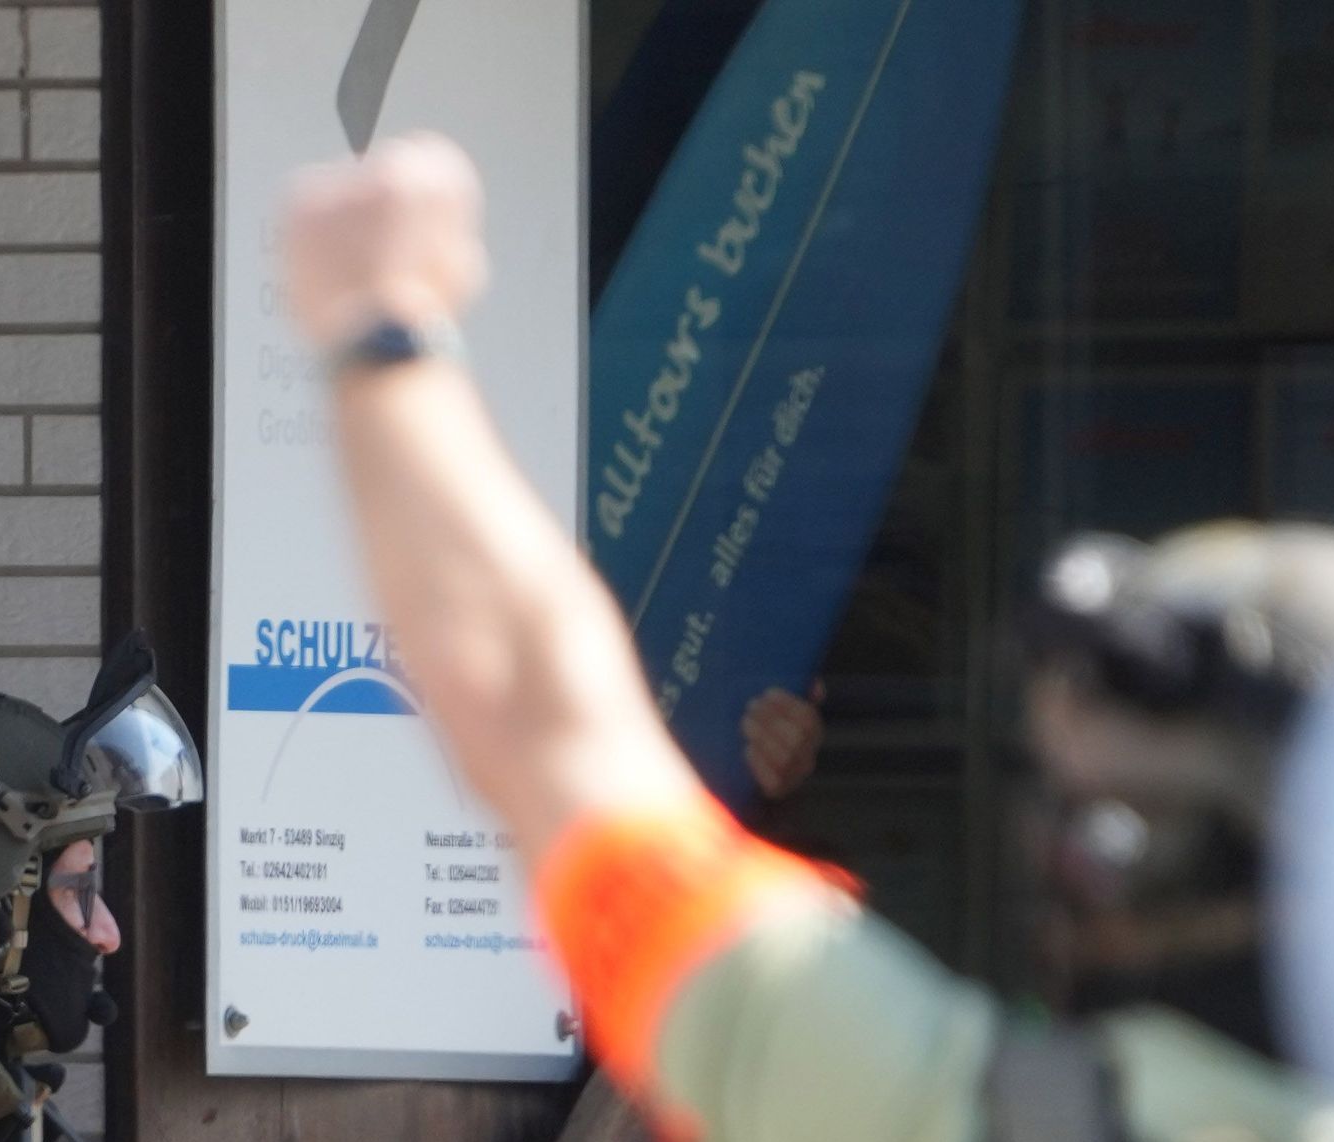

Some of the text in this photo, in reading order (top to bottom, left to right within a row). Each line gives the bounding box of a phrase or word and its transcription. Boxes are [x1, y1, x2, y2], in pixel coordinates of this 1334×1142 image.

[597, 70, 826, 538] alltours buchen
[710, 504, 759, 588] alles
[743, 446, 785, 501] für
[315, 828, 346, 851] Sinzig
